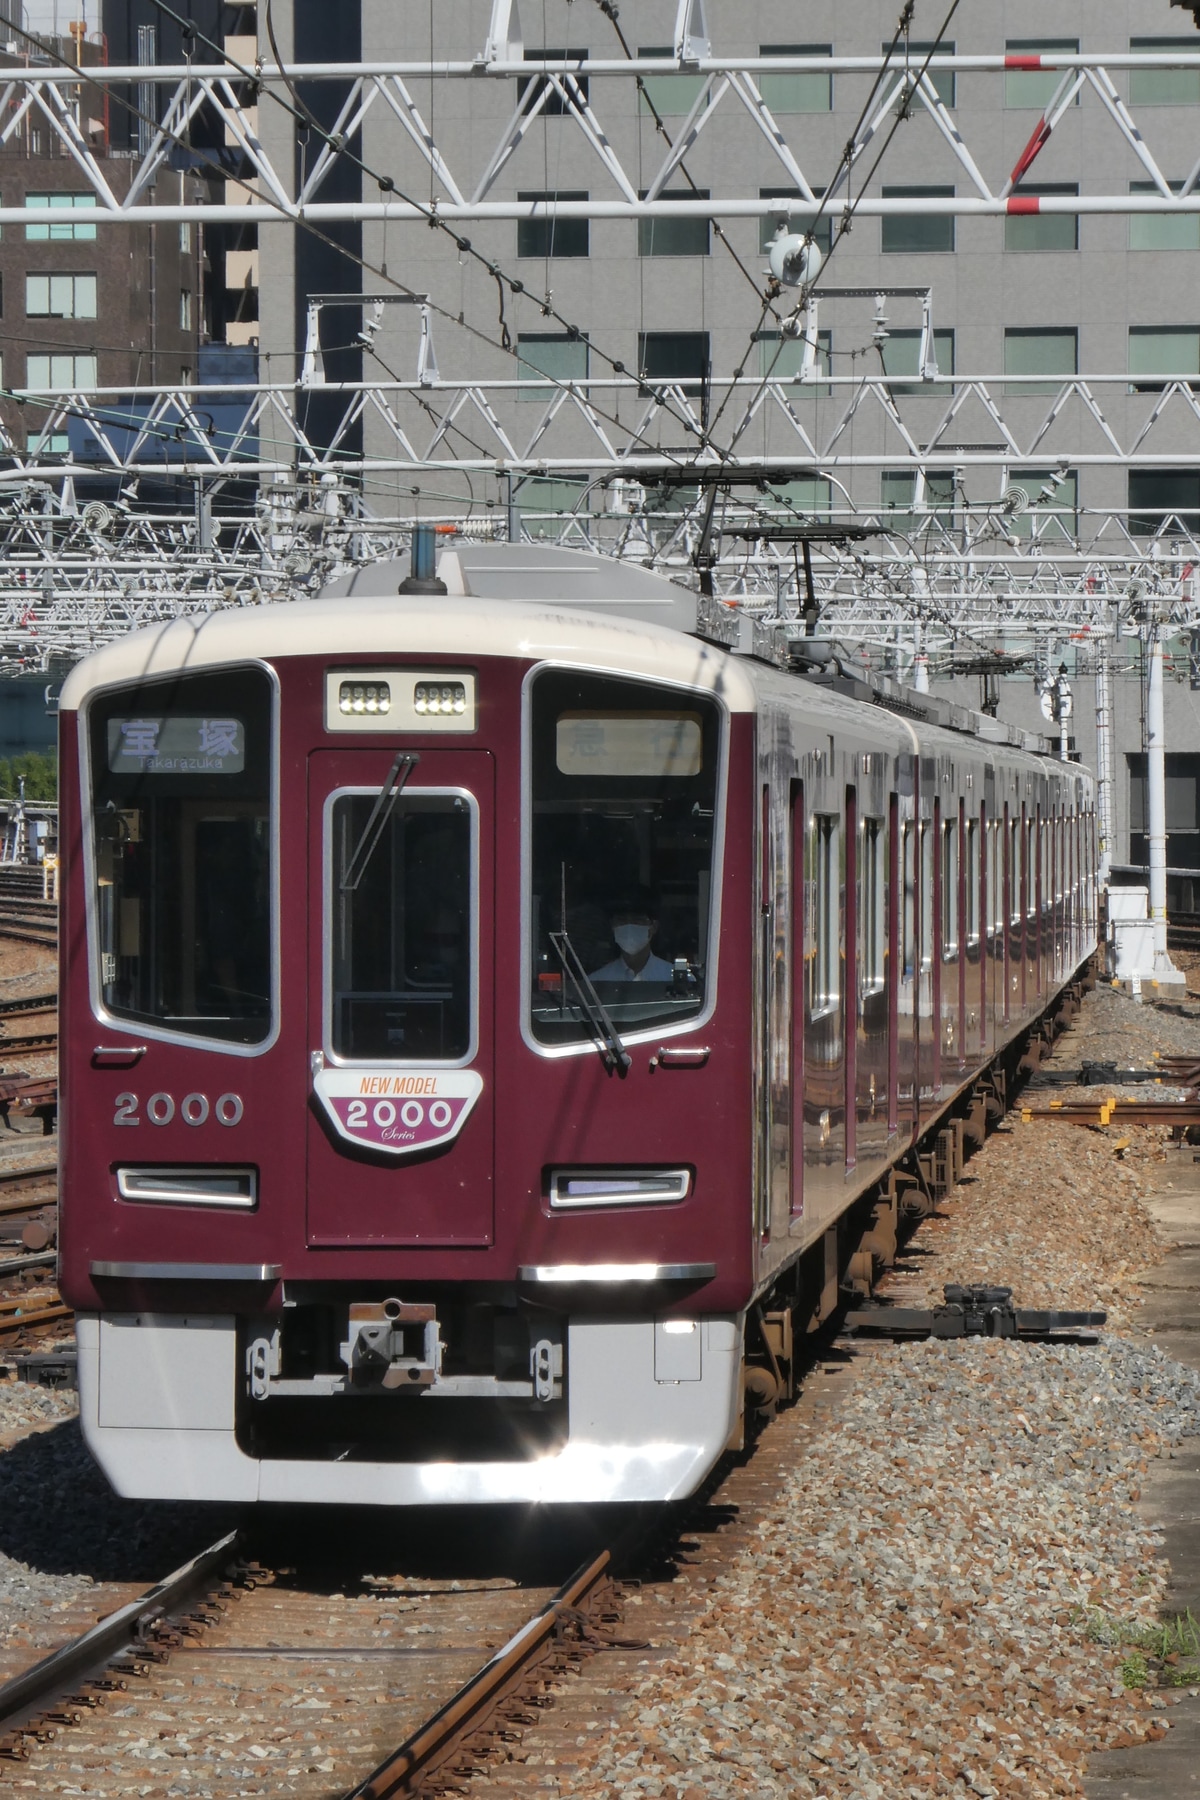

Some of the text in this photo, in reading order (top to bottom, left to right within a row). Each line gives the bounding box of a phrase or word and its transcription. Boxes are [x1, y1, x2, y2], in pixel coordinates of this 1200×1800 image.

[121, 720, 239, 757] 宝塚
[139, 757, 223, 769] Takarazuka
[360, 1077, 438, 1095] NEW MODEL
[113, 1092, 244, 1127] 2000
[346, 1100, 452, 1127] 2000
[381, 1126, 415, 1141] Series
